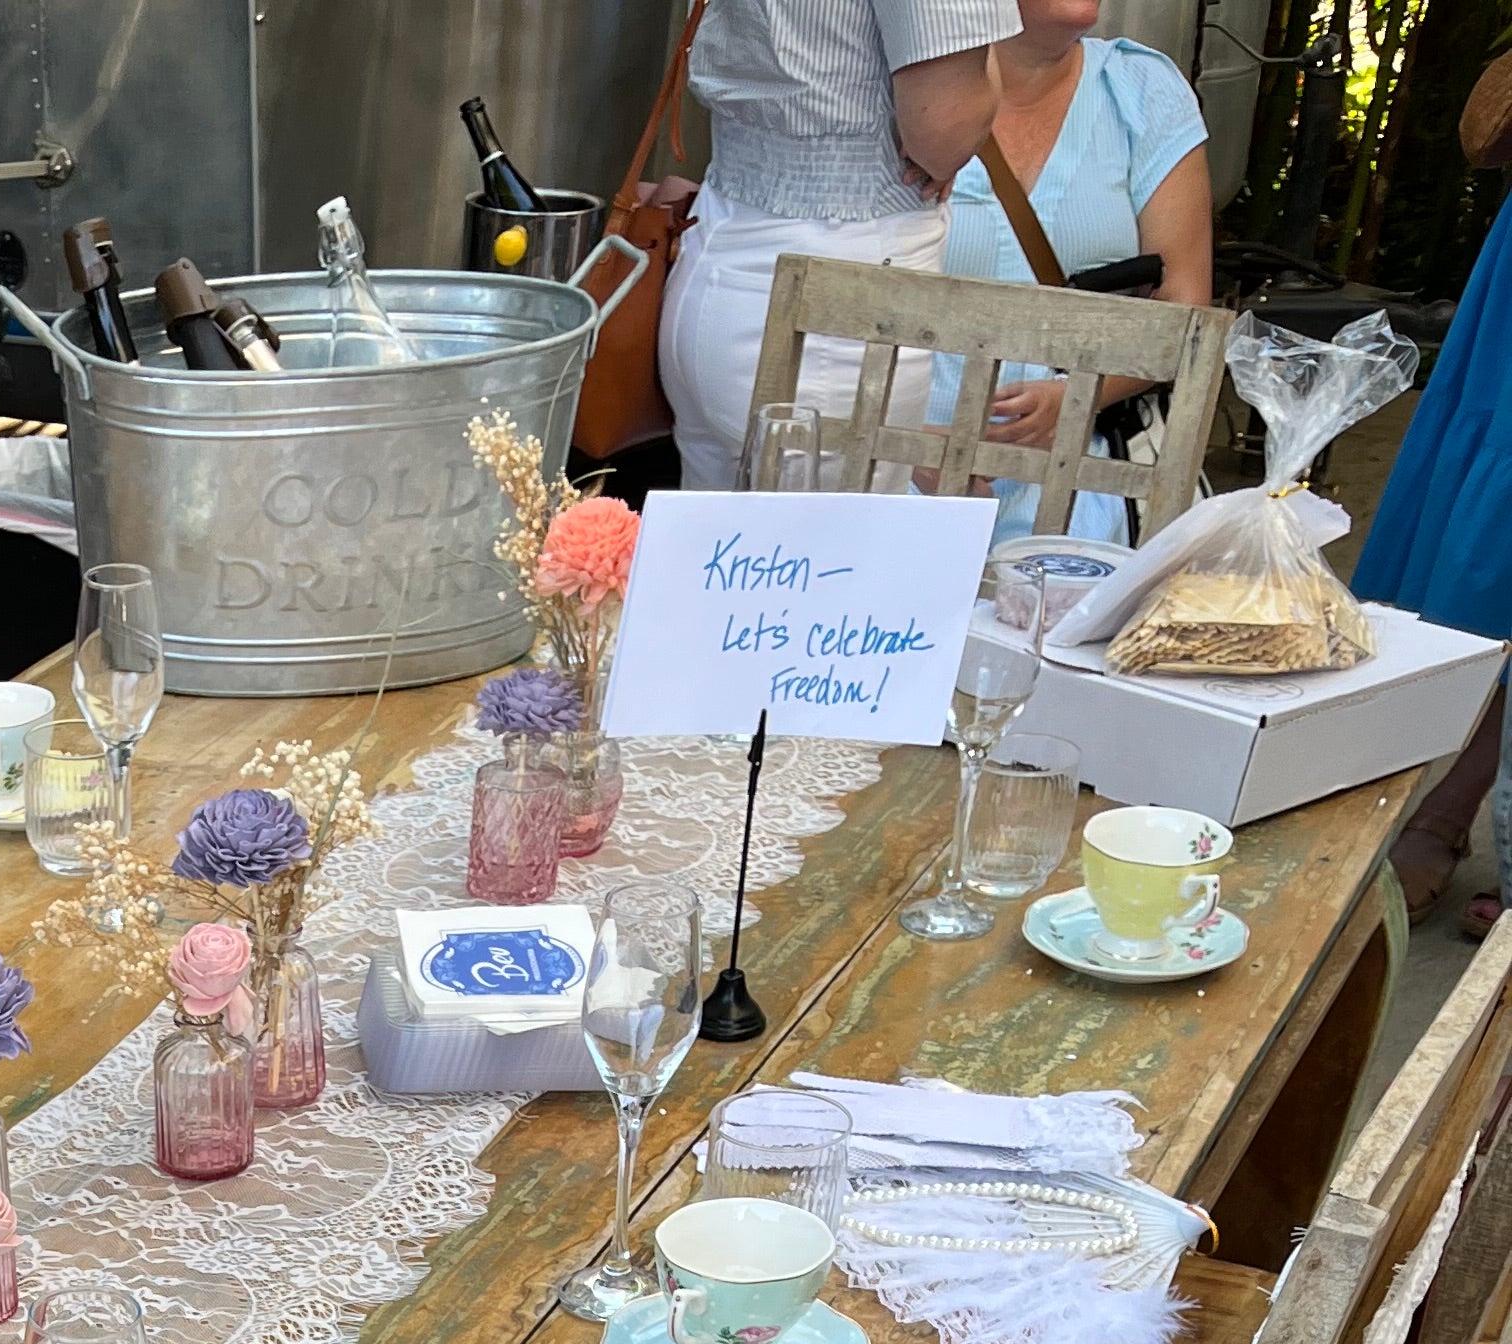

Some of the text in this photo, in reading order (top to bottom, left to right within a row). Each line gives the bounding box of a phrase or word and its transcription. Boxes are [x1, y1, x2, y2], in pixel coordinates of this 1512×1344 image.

[262, 460, 490, 529] COLD
[212, 542, 498, 613] DRINK
[722, 609, 790, 652] Let's
[769, 663, 891, 713] Freedom!
